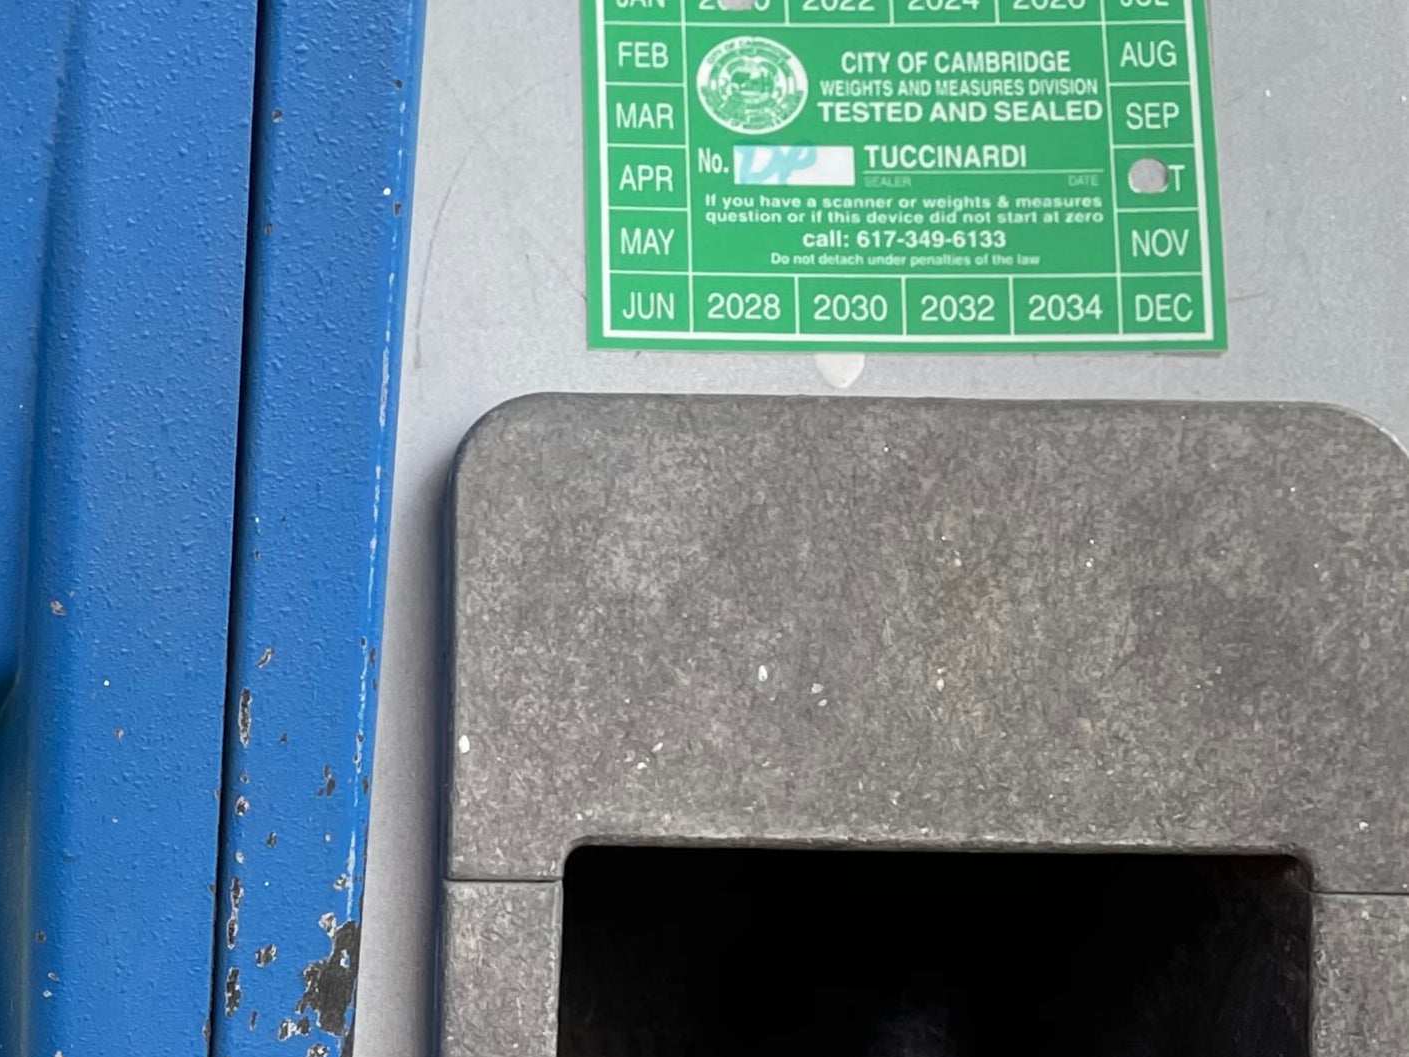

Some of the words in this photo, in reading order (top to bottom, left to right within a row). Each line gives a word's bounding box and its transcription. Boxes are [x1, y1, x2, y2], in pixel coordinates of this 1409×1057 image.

[618, 42, 669, 68] FEB
[841, 51, 890, 74] CITY
[897, 51, 928, 74] OF
[934, 50, 1071, 73] CAMBRIDGE
[1120, 41, 1177, 68] AUG
[820, 80, 893, 97] WEIGHTS
[897, 80, 932, 97] AND
[935, 79, 1025, 96] MEASURES
[1029, 78, 1098, 95] DIVISION
[616, 103, 674, 130] MAR
[817, 102, 923, 122] TESTED
[929, 102, 987, 122] AND
[993, 100, 1103, 122] SEALED
[1126, 102, 1180, 131] SEP
[697, 147, 730, 174] No.
[864, 144, 1027, 169] TUCCINARDI
[619, 164, 674, 193] APR
[864, 176, 912, 188] SEALER
[1068, 175, 1099, 187] DATE
[705, 194, 716, 207] If
[722, 196, 754, 210] you
[759, 195, 801, 208] have
[806, 198, 817, 208] a
[822, 197, 893, 208] scanner
[898, 197, 916, 208] or
[922, 195, 991, 211] weights
[997, 195, 1009, 209] &
[1015, 196, 1102, 208] measures
[705, 211, 782, 224] question
[787, 213, 805, 223] or
[811, 211, 822, 223] if
[828, 211, 861, 223] this
[866, 211, 924, 223] device
[929, 211, 958, 223] did
[963, 212, 991, 223] not
[997, 212, 1037, 223] start
[1043, 212, 1059, 223] at
[1065, 212, 1104, 223] zero
[620, 228, 675, 256] MAY
[802, 229, 849, 248] call:
[856, 229, 1007, 248] 617-349-6133
[1132, 229, 1190, 258] NOV
[771, 252, 790, 265] Do
[793, 253, 815, 265] not
[818, 252, 864, 265] detach
[868, 253, 906, 266] under
[910, 253, 971, 267] penalties
[975, 253, 989, 265] of
[992, 253, 1014, 265] the
[1017, 253, 1040, 265] law
[622, 292, 675, 321] JUN
[707, 292, 782, 321] 2028
[813, 293, 889, 323] 2030
[920, 294, 996, 323] 2032
[1028, 293, 1104, 322] 2034
[1134, 293, 1194, 323] DEC
